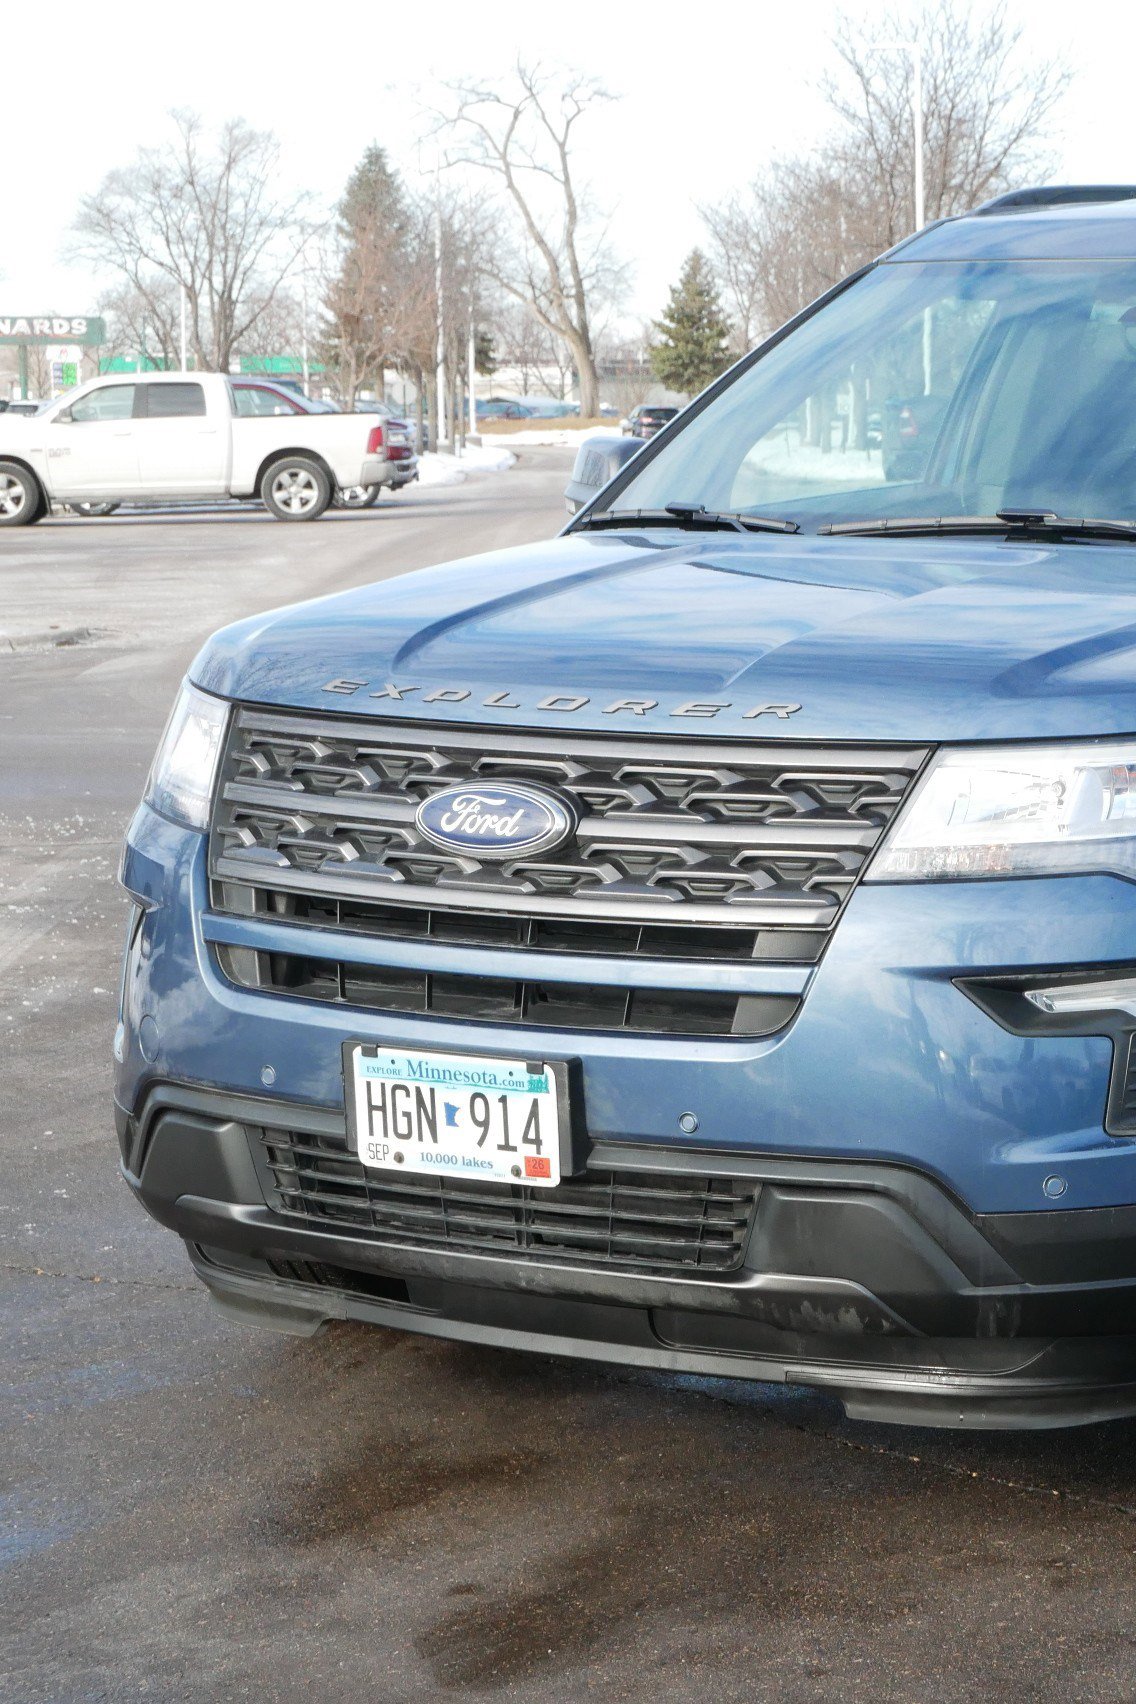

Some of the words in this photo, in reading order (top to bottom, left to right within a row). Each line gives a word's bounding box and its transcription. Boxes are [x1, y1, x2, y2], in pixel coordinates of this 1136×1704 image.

[321, 677, 803, 719] EXPLORER
[441, 794, 521, 838] Ford
[366, 1065, 402, 1077] EXPLORE
[366, 1080, 438, 1144] HGN
[469, 1091, 543, 1155] 914
[367, 1142, 390, 1162] SEP
[419, 1151, 458, 1166] 10,000
[461, 1155, 494, 1170] lakes
[531, 1158, 545, 1171] 26
